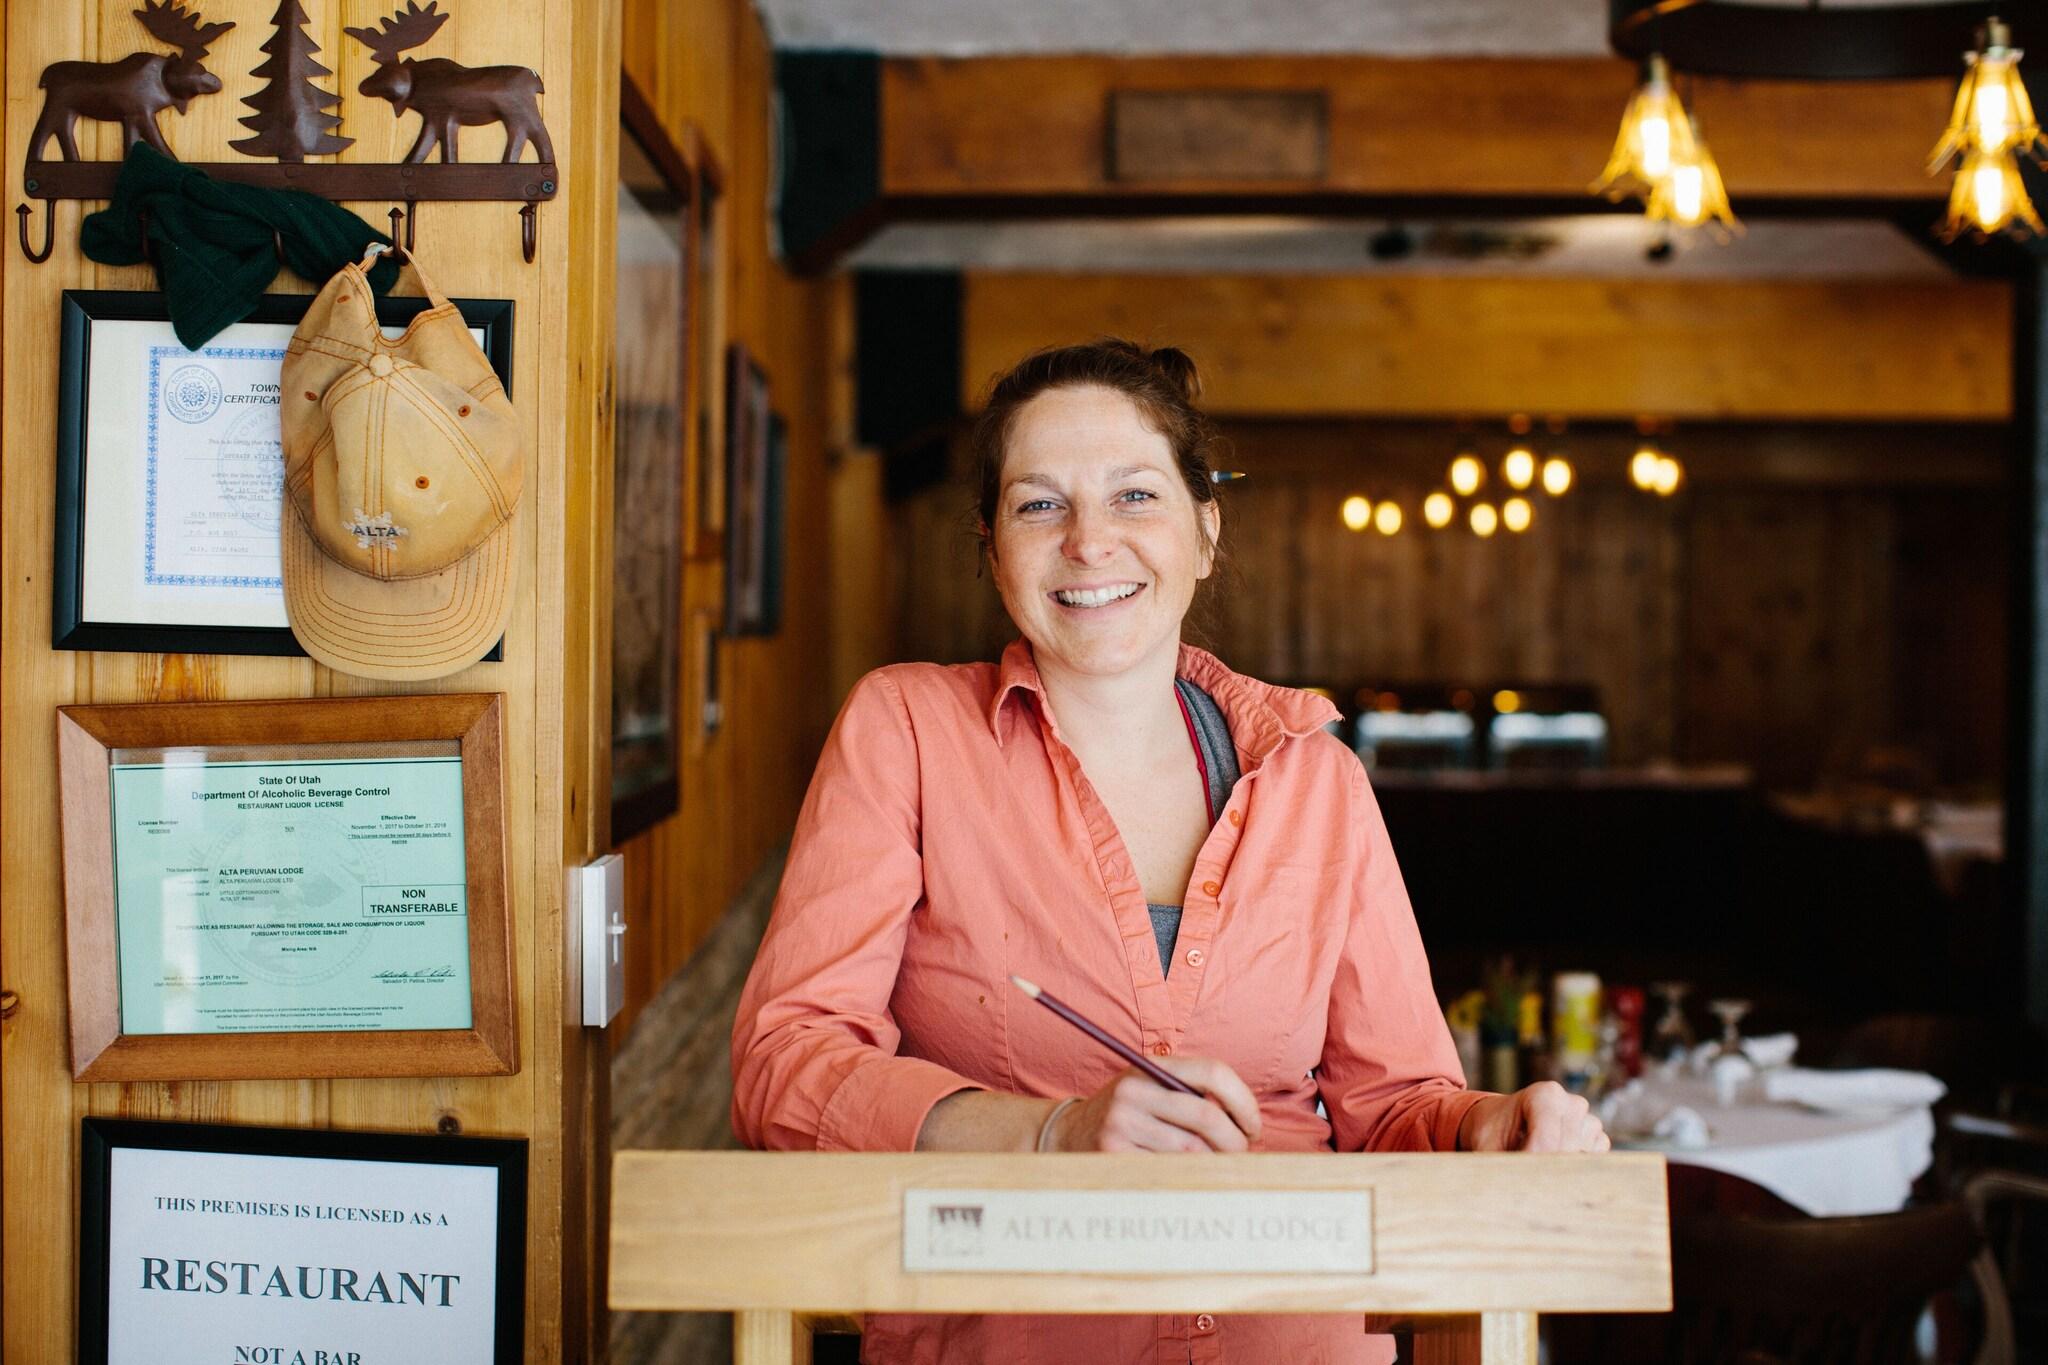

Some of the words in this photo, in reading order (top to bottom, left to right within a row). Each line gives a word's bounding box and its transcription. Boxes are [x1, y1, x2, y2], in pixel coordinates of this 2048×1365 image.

[353, 525, 399, 537] ALTA
[258, 776, 283, 785] State
[285, 776, 297, 785] Of
[299, 775, 321, 784] Utah
[191, 790, 246, 801] Department
[248, 790, 259, 799] Of
[261, 788, 306, 799] Alcoholic
[308, 788, 353, 799] Beverage
[355, 787, 390, 797] Control
[237, 801, 284, 809] RESTAURANT
[285, 801, 312, 809] LIQUOR
[314, 800, 345, 808] LICENSE
[219, 868, 239, 876] ALTA
[240, 867, 277, 876] PERUVIAN
[278, 866, 304, 875] LODGE
[402, 889, 426, 899] NON
[370, 902, 458, 914] TRANSFERABLE
[298, 921, 326, 929] STORAGE,
[354, 920, 394, 928] CONSUMPTION
[154, 1197, 196, 1212] THIS
[201, 1199, 289, 1217] PREMISES
[295, 1204, 311, 1218] IS
[316, 1206, 405, 1224] LICENSED
[409, 1211, 432, 1225] AS
[436, 1213, 449, 1226] A
[1003, 1215, 1074, 1241] ALTA
[1084, 1215, 1233, 1242] PERUVIAN
[1248, 1215, 1348, 1242] LODGE
[140, 1256, 461, 1307] RESTAURANT
[234, 1345, 285, 1364] NOT
[290, 1349, 310, 1365] A
[314, 1349, 363, 1365] BAR
